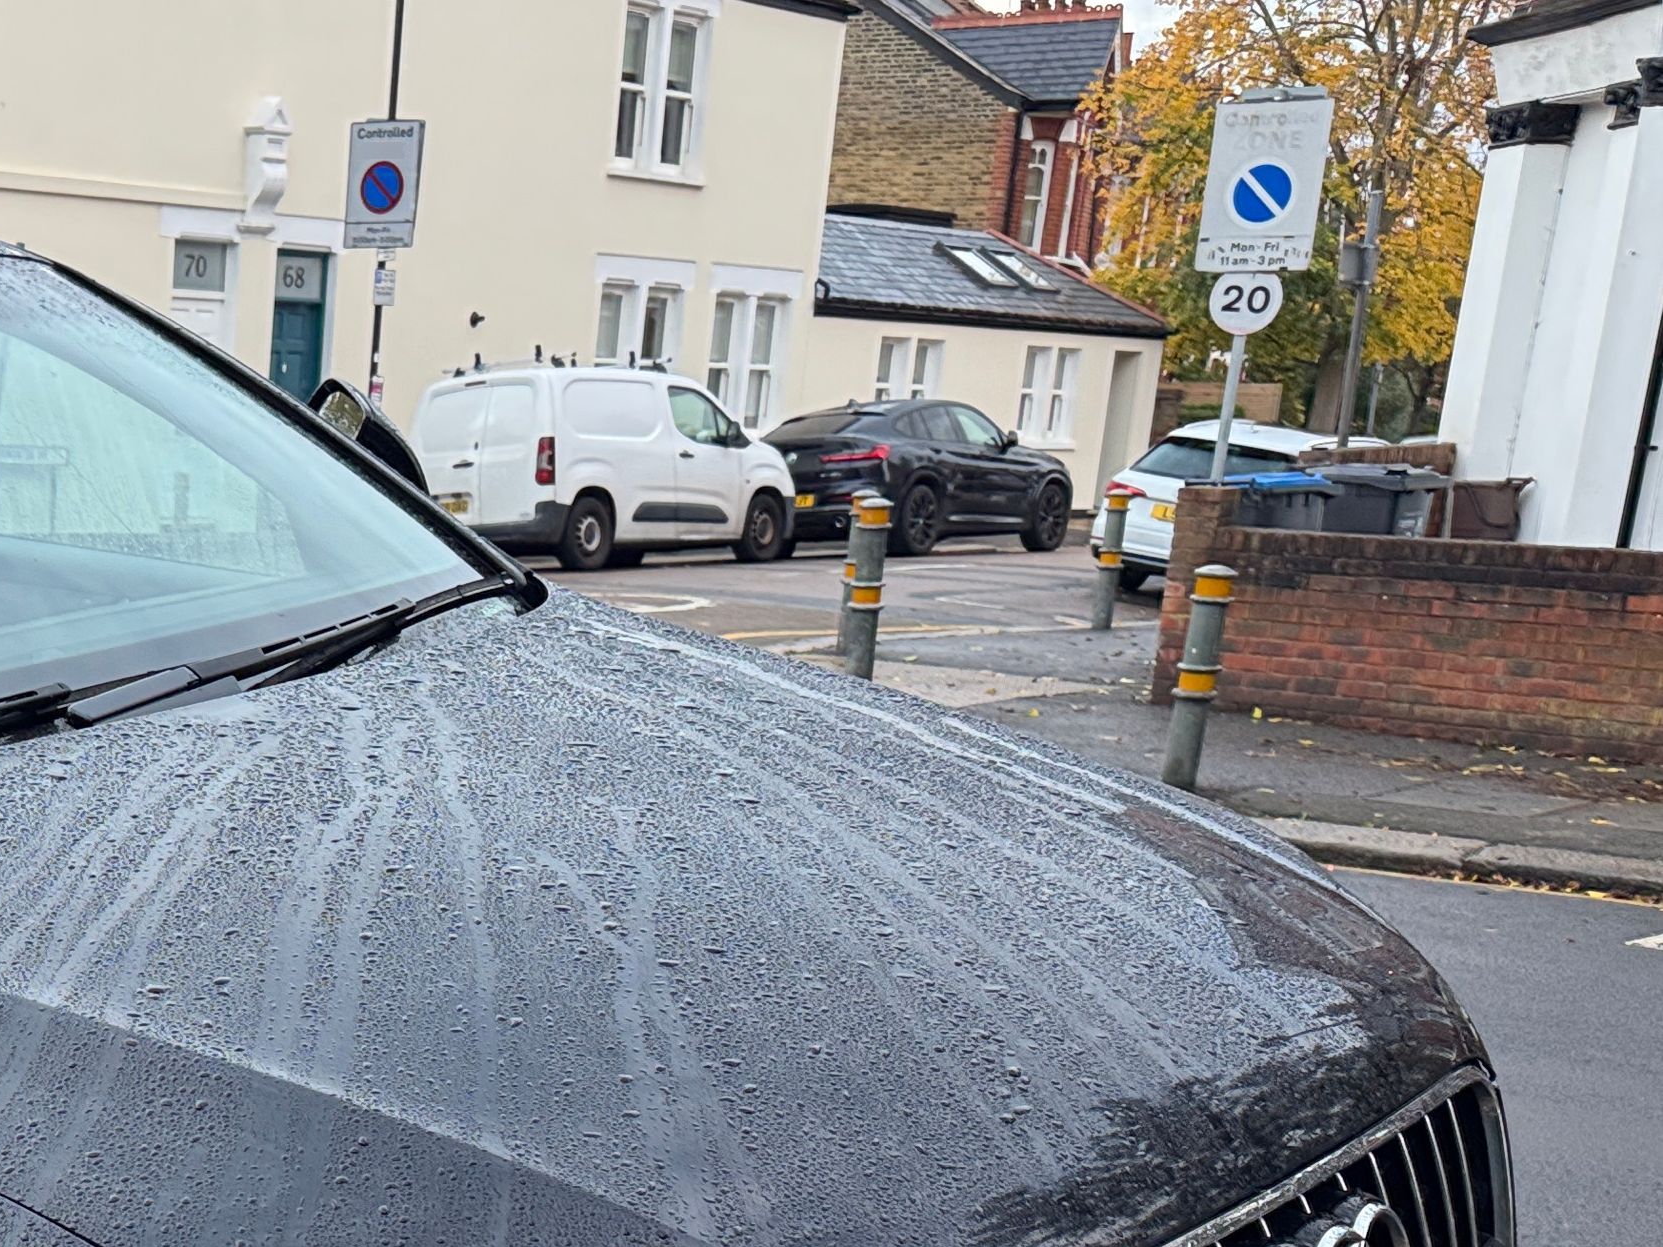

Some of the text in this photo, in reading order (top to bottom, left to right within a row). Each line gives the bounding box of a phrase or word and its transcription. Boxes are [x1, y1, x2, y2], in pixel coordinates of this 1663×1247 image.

[357, 126, 415, 140] Controlled
[1230, 242, 1255, 253] Mon
[1264, 241, 1280, 252] Fri
[183, 253, 208, 278] 70
[282, 264, 306, 289] 68
[1220, 285, 1272, 315] 20
